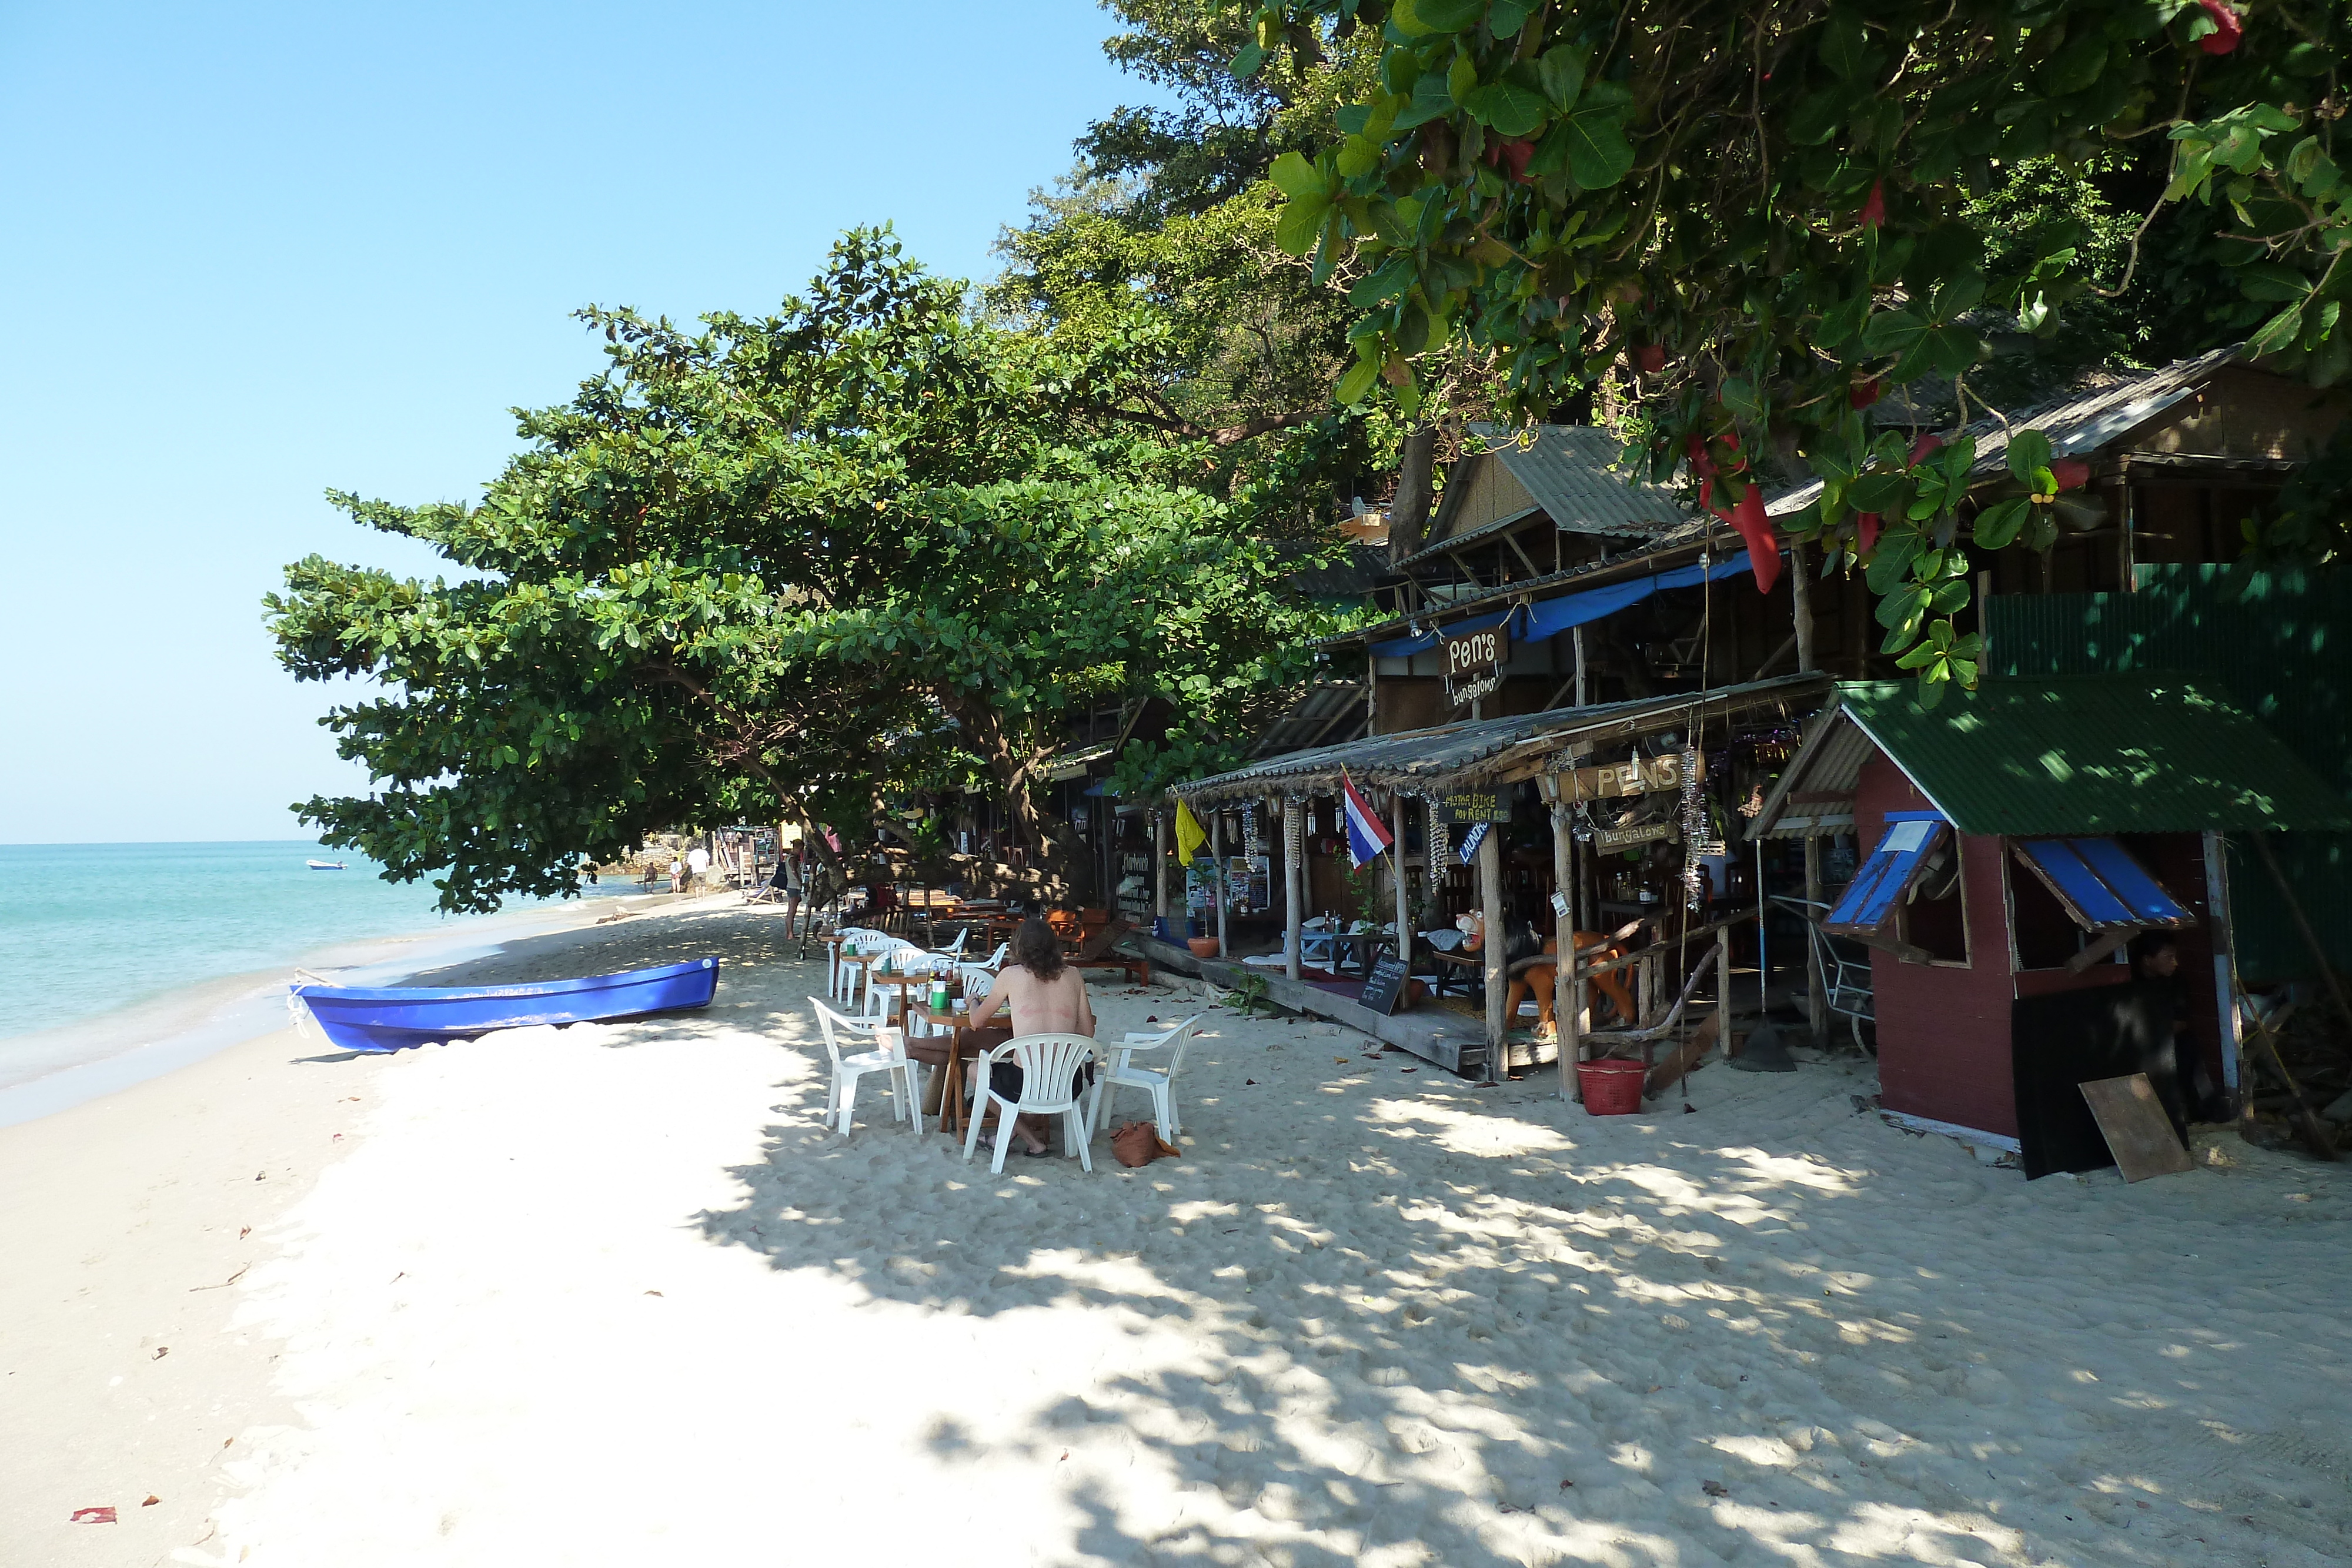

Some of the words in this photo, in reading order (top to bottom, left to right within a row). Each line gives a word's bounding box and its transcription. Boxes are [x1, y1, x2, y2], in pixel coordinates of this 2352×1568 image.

[1452, 677, 1496, 706] bungalows
[1598, 760, 1677, 796] PEN'S
[1472, 793, 1496, 808] BIKE
[1605, 825, 1665, 842] bungalows
